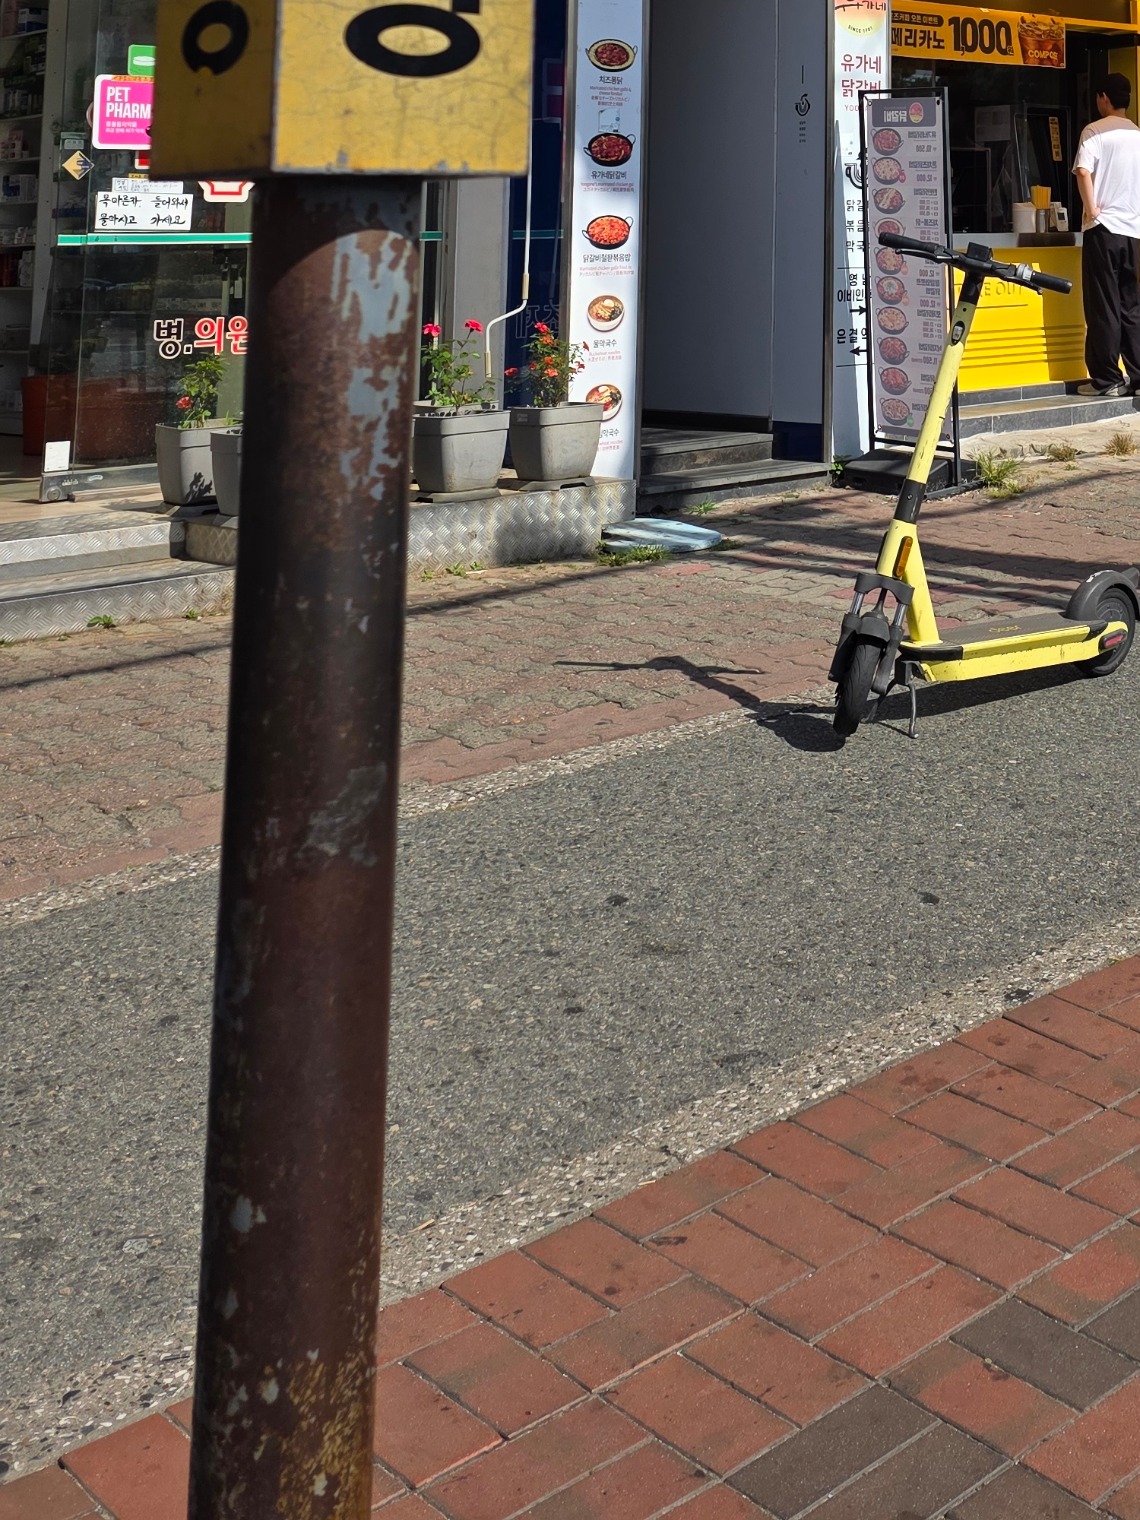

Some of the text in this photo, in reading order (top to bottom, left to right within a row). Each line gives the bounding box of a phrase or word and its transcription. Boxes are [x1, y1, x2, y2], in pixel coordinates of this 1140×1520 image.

[891, 27, 945, 49] 메리카노
[841, 54, 882, 74] 유가네
[106, 86, 131, 103] PET
[150, 213, 186, 226] 가세요
